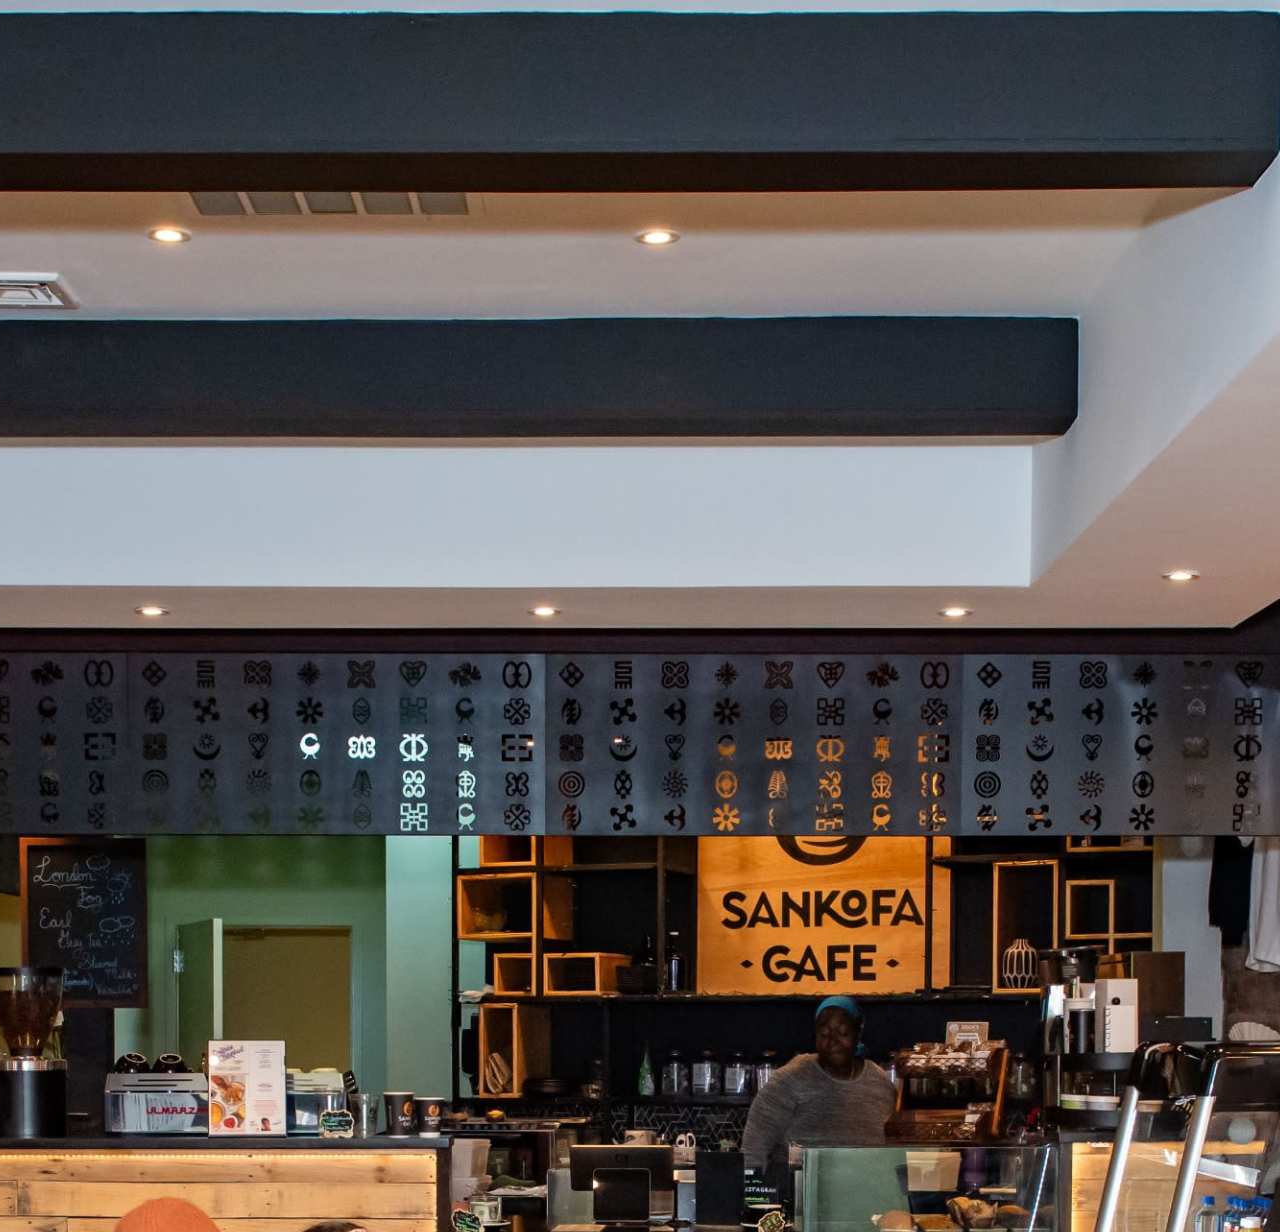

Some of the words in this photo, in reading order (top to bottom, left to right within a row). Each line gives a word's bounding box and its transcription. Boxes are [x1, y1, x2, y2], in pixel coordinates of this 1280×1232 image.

[33, 855, 96, 882] London
[721, 889, 925, 930] SANKOFA
[761, 944, 877, 983] CAFE
